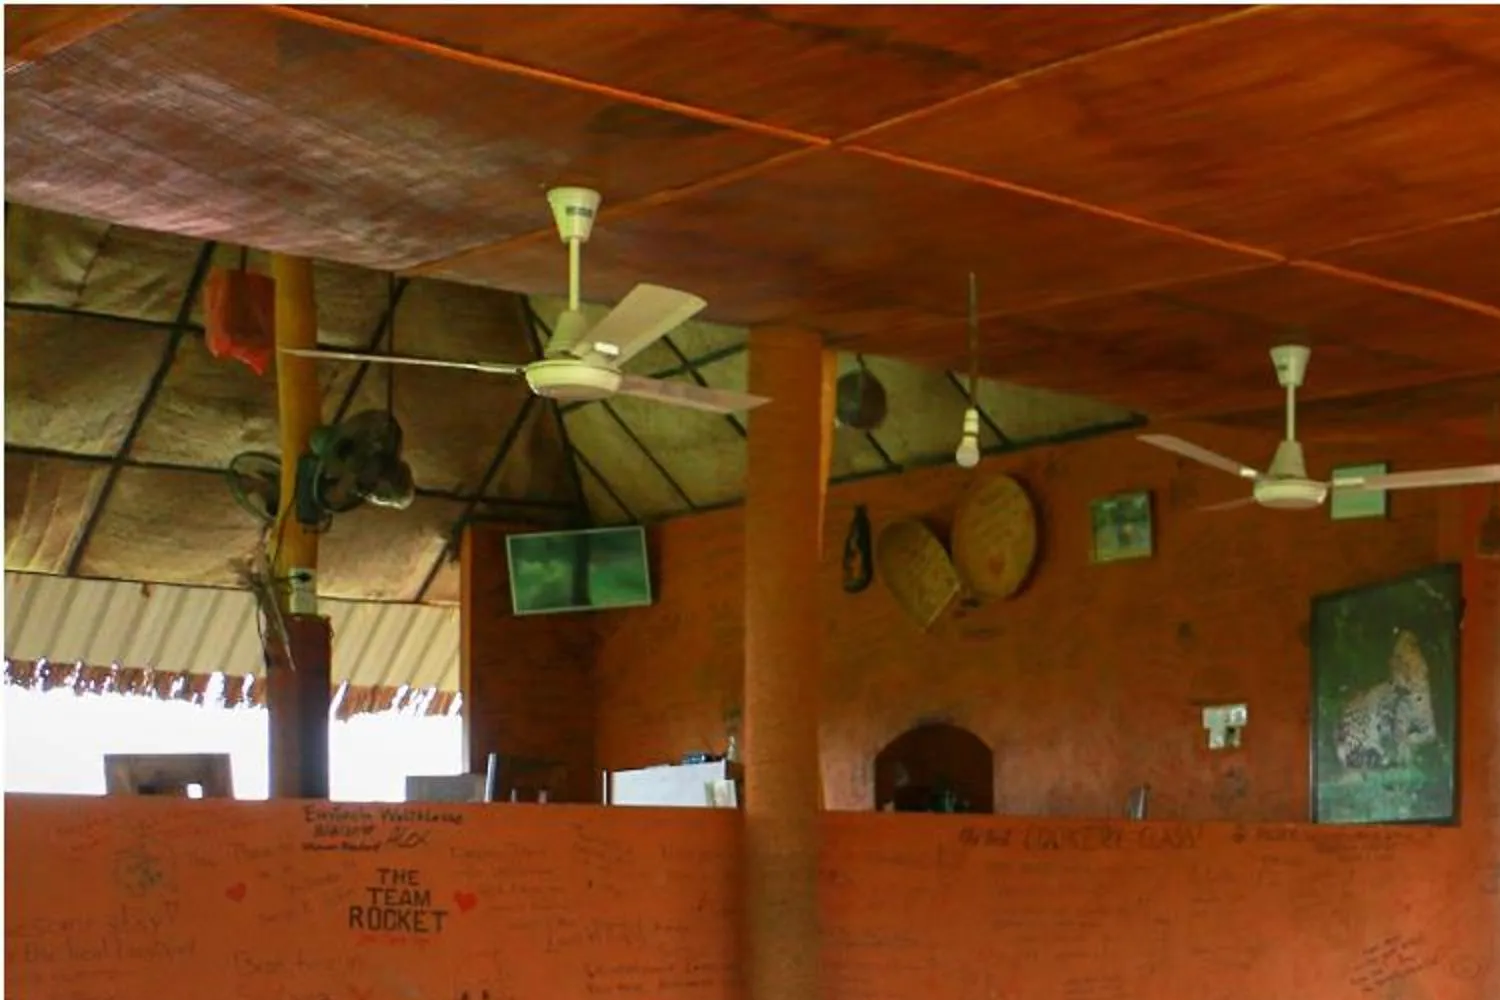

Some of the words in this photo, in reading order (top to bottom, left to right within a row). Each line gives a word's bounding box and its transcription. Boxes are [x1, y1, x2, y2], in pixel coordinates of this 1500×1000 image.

[376, 868, 420, 886] THE
[366, 887, 431, 907] TEAM
[349, 906, 449, 933] ROCKET
